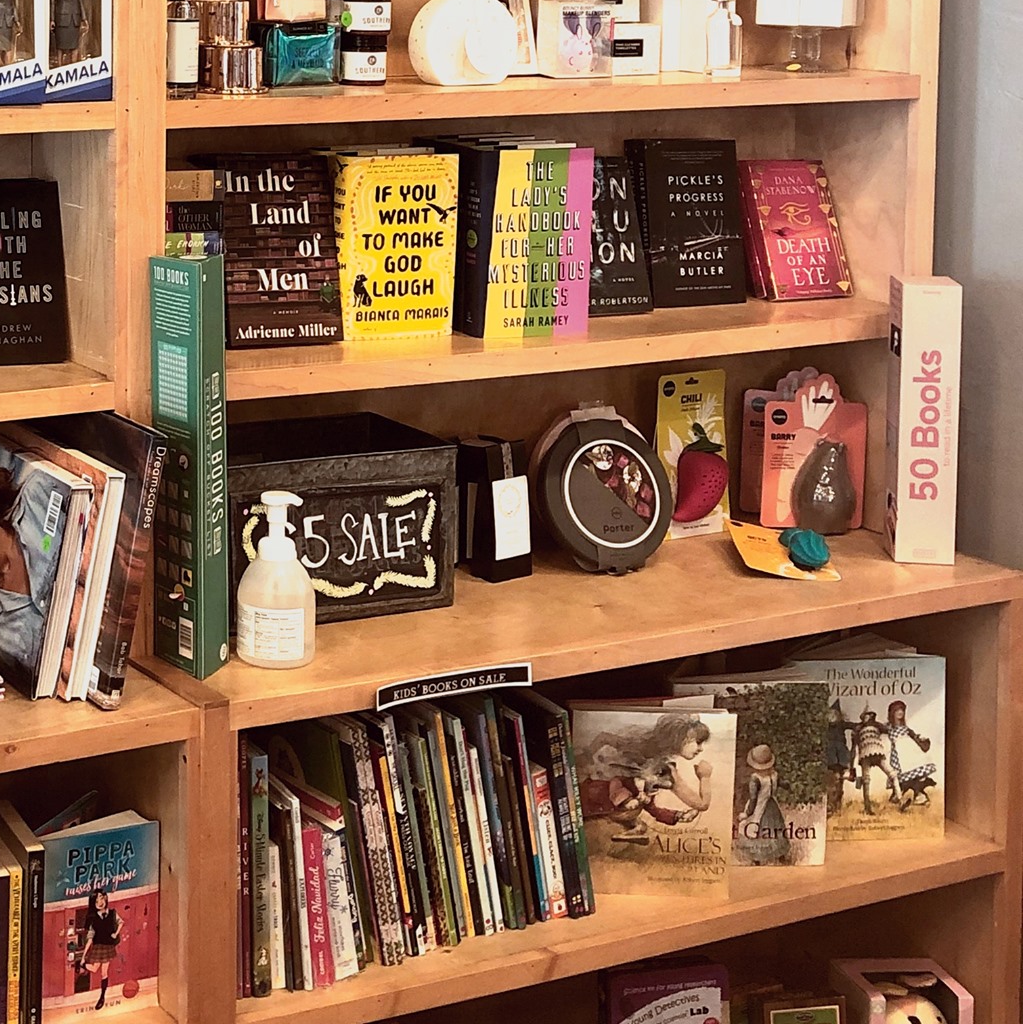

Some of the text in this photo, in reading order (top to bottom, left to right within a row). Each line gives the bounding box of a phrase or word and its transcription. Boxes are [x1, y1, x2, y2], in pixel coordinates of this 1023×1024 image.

[45, 59, 110, 90] KAMALA
[225, 168, 296, 194] In the
[526, 160, 555, 182] THE
[667, 173, 724, 188] PICKLE'S
[375, 184, 437, 204] IF YOU
[510, 185, 569, 207] LADY'S
[668, 192, 724, 203] PROGRESS
[250, 200, 312, 226] Land
[378, 207, 433, 225] WANT
[495, 210, 583, 234] HANDBOOK
[298, 232, 323, 258] of
[362, 230, 445, 251] TO MAKE
[776, 236, 831, 256] DEATH
[384, 255, 423, 274] GOD
[678, 250, 725, 262] MARCIA
[153, 265, 190, 286] 100 BOOKS
[256, 268, 310, 292] Men
[679, 264, 725, 278] BUTLER
[792, 266, 831, 287] EYE
[372, 278, 435, 298] LAUGH
[503, 286, 570, 310] ILLNESS
[355, 306, 450, 323] BIANCA MARAIS
[503, 314, 570, 329] SARAH RAMEY
[235, 324, 338, 340] Adrienne Miller
[680, 393, 703, 404] CHILI
[908, 348, 942, 502] 50 Books
[770, 432, 797, 442] BARRY
[142, 446, 167, 531] Dreamscapes
[603, 523, 635, 534] porter
[393, 672, 507, 701] KIDS' BOOKS ON SALE
[66, 840, 135, 868] PIPPA
